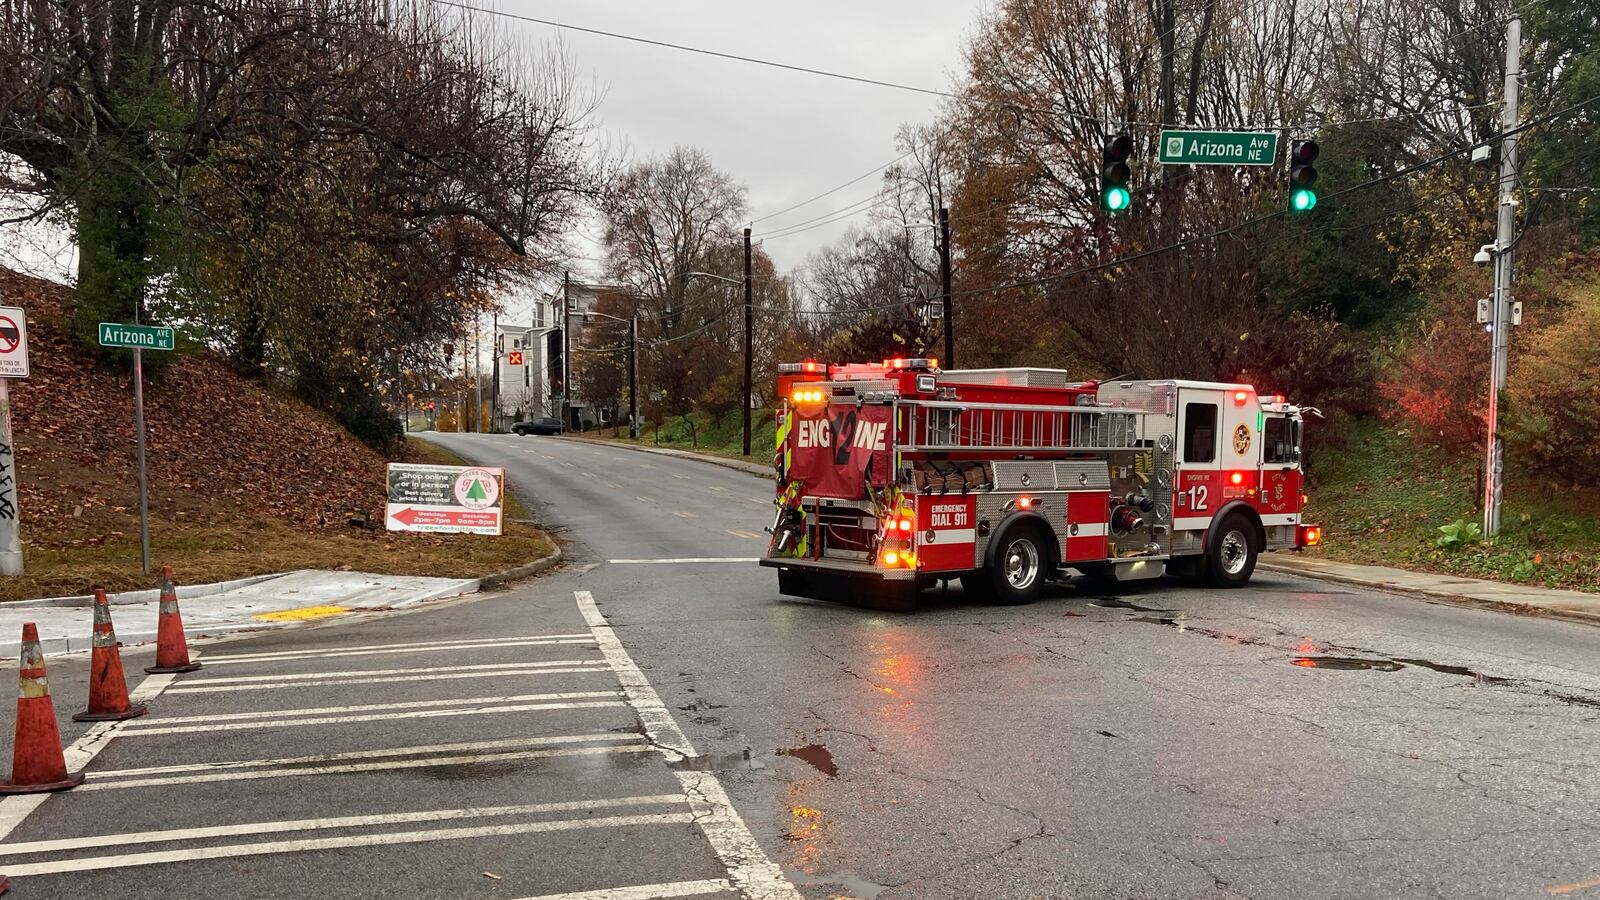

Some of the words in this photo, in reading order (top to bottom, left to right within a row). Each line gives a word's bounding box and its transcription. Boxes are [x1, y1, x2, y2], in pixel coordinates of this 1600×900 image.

[1188, 140, 1243, 156] Arizona
[1249, 138, 1269, 148] Ave
[1248, 150, 1261, 160] NE
[104, 327, 154, 345] Arizona
[156, 329, 169, 338] AVE
[158, 339, 168, 348] NE
[402, 472, 423, 480] Shop
[425, 473, 449, 481] online
[1188, 485, 1208, 511] 12
[931, 504, 968, 513] EMERGENCY
[931, 513, 952, 527] DIAL
[954, 513, 967, 526] 911
